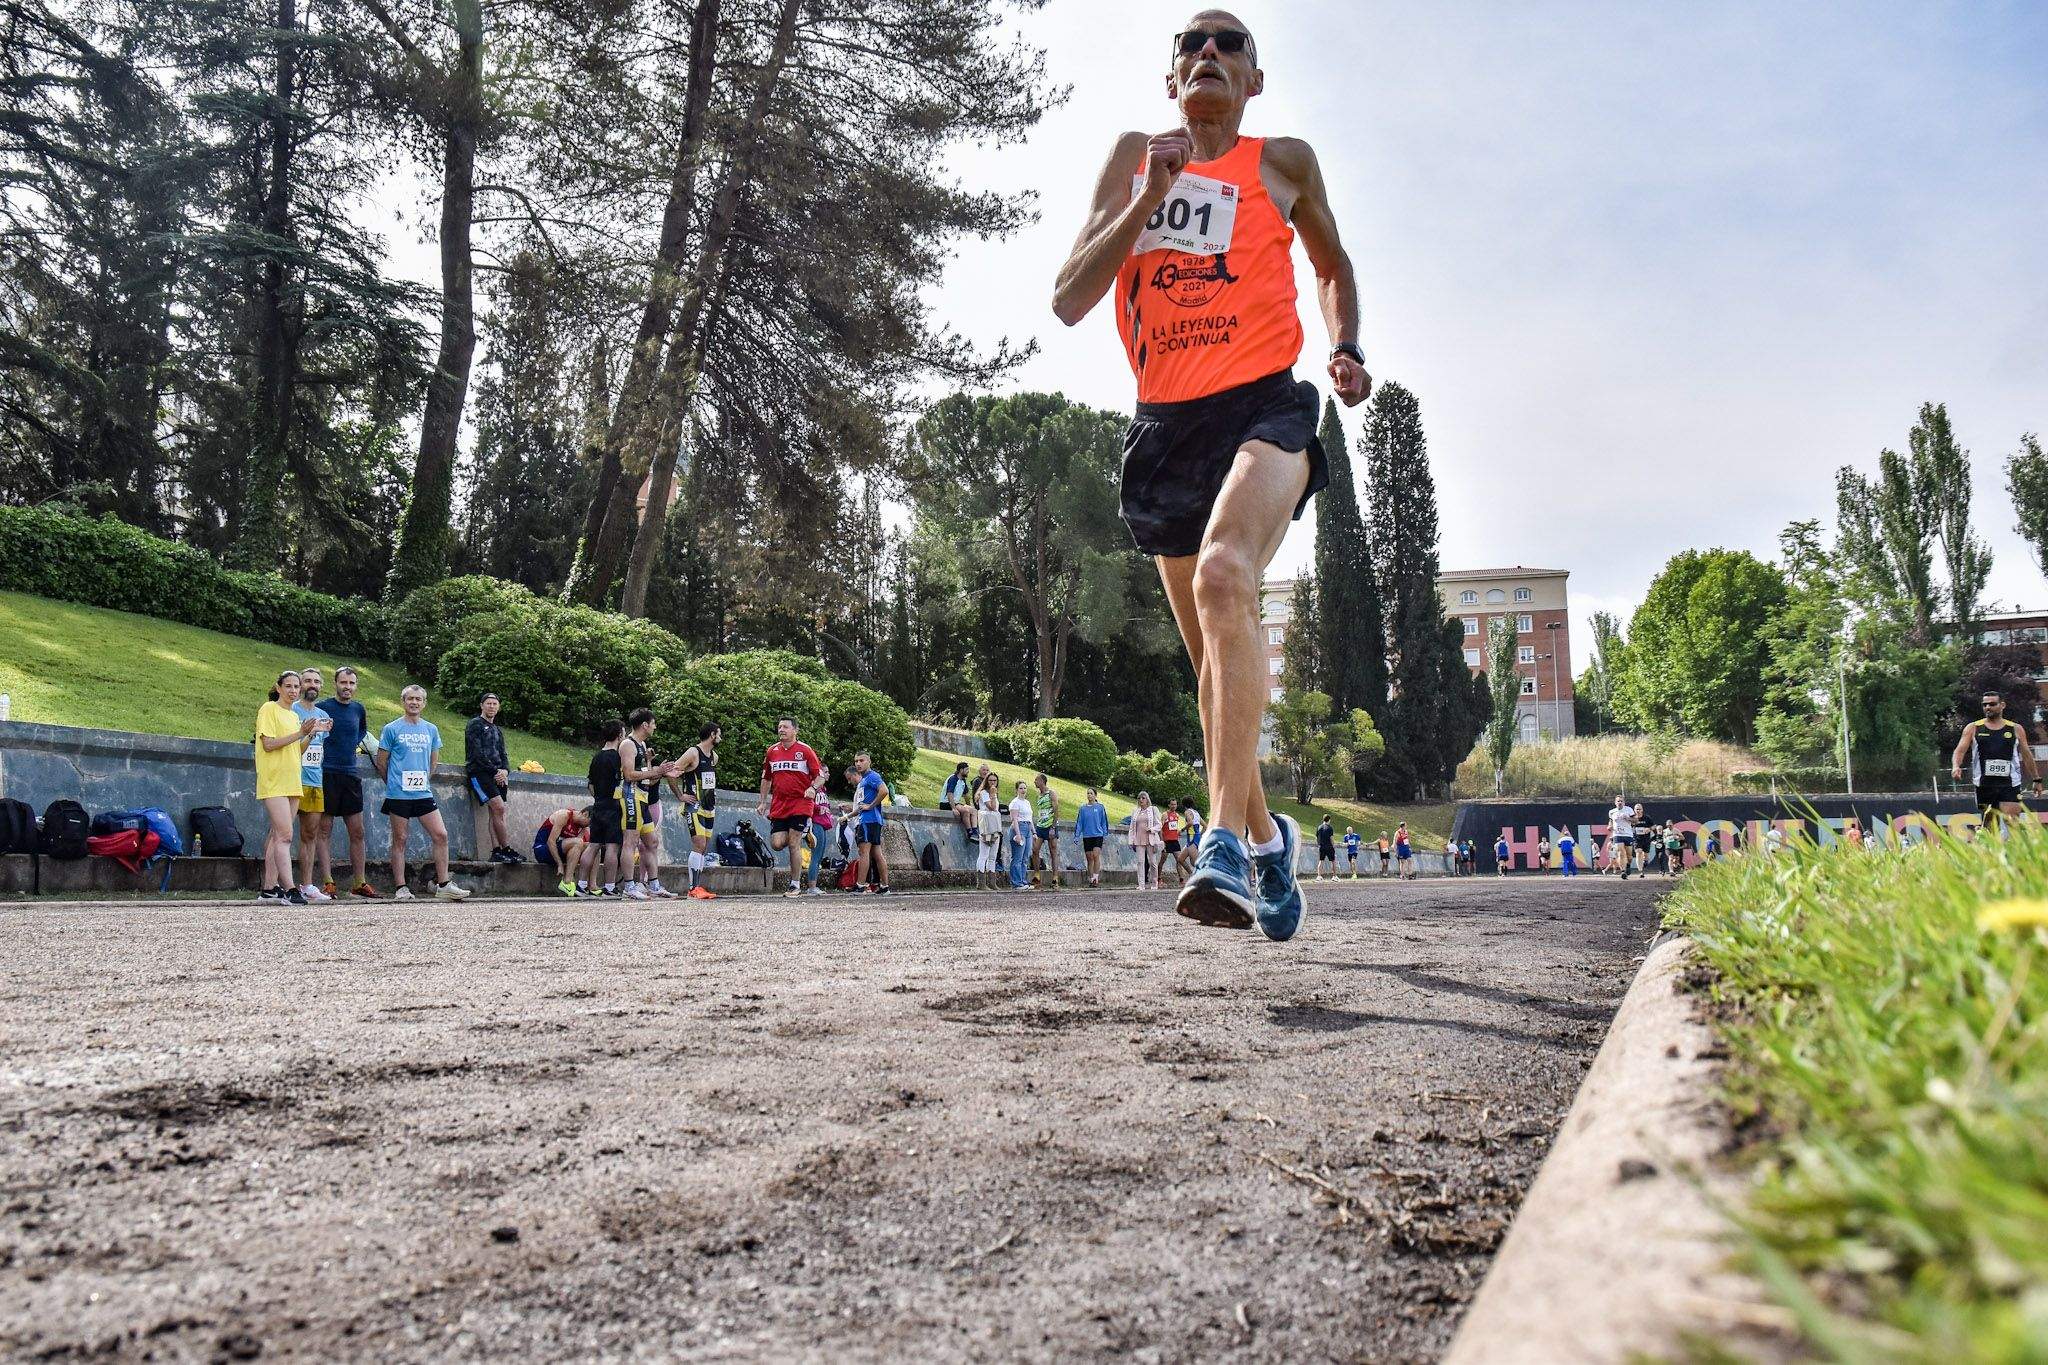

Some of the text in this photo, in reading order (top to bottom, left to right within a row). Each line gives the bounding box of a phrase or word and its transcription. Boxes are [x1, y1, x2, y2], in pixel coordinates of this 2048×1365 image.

[1182, 257, 1206, 266] 1978
[1178, 268, 1218, 279] EDICIONES
[1182, 281, 1206, 292] 2021
[1152, 315, 1238, 340] LA LEYENDA
[398, 733, 430, 743] SPORT
[772, 762, 799, 770] FIRE
[1989, 765, 2006, 773] 898
[407, 777, 424, 786] 722
